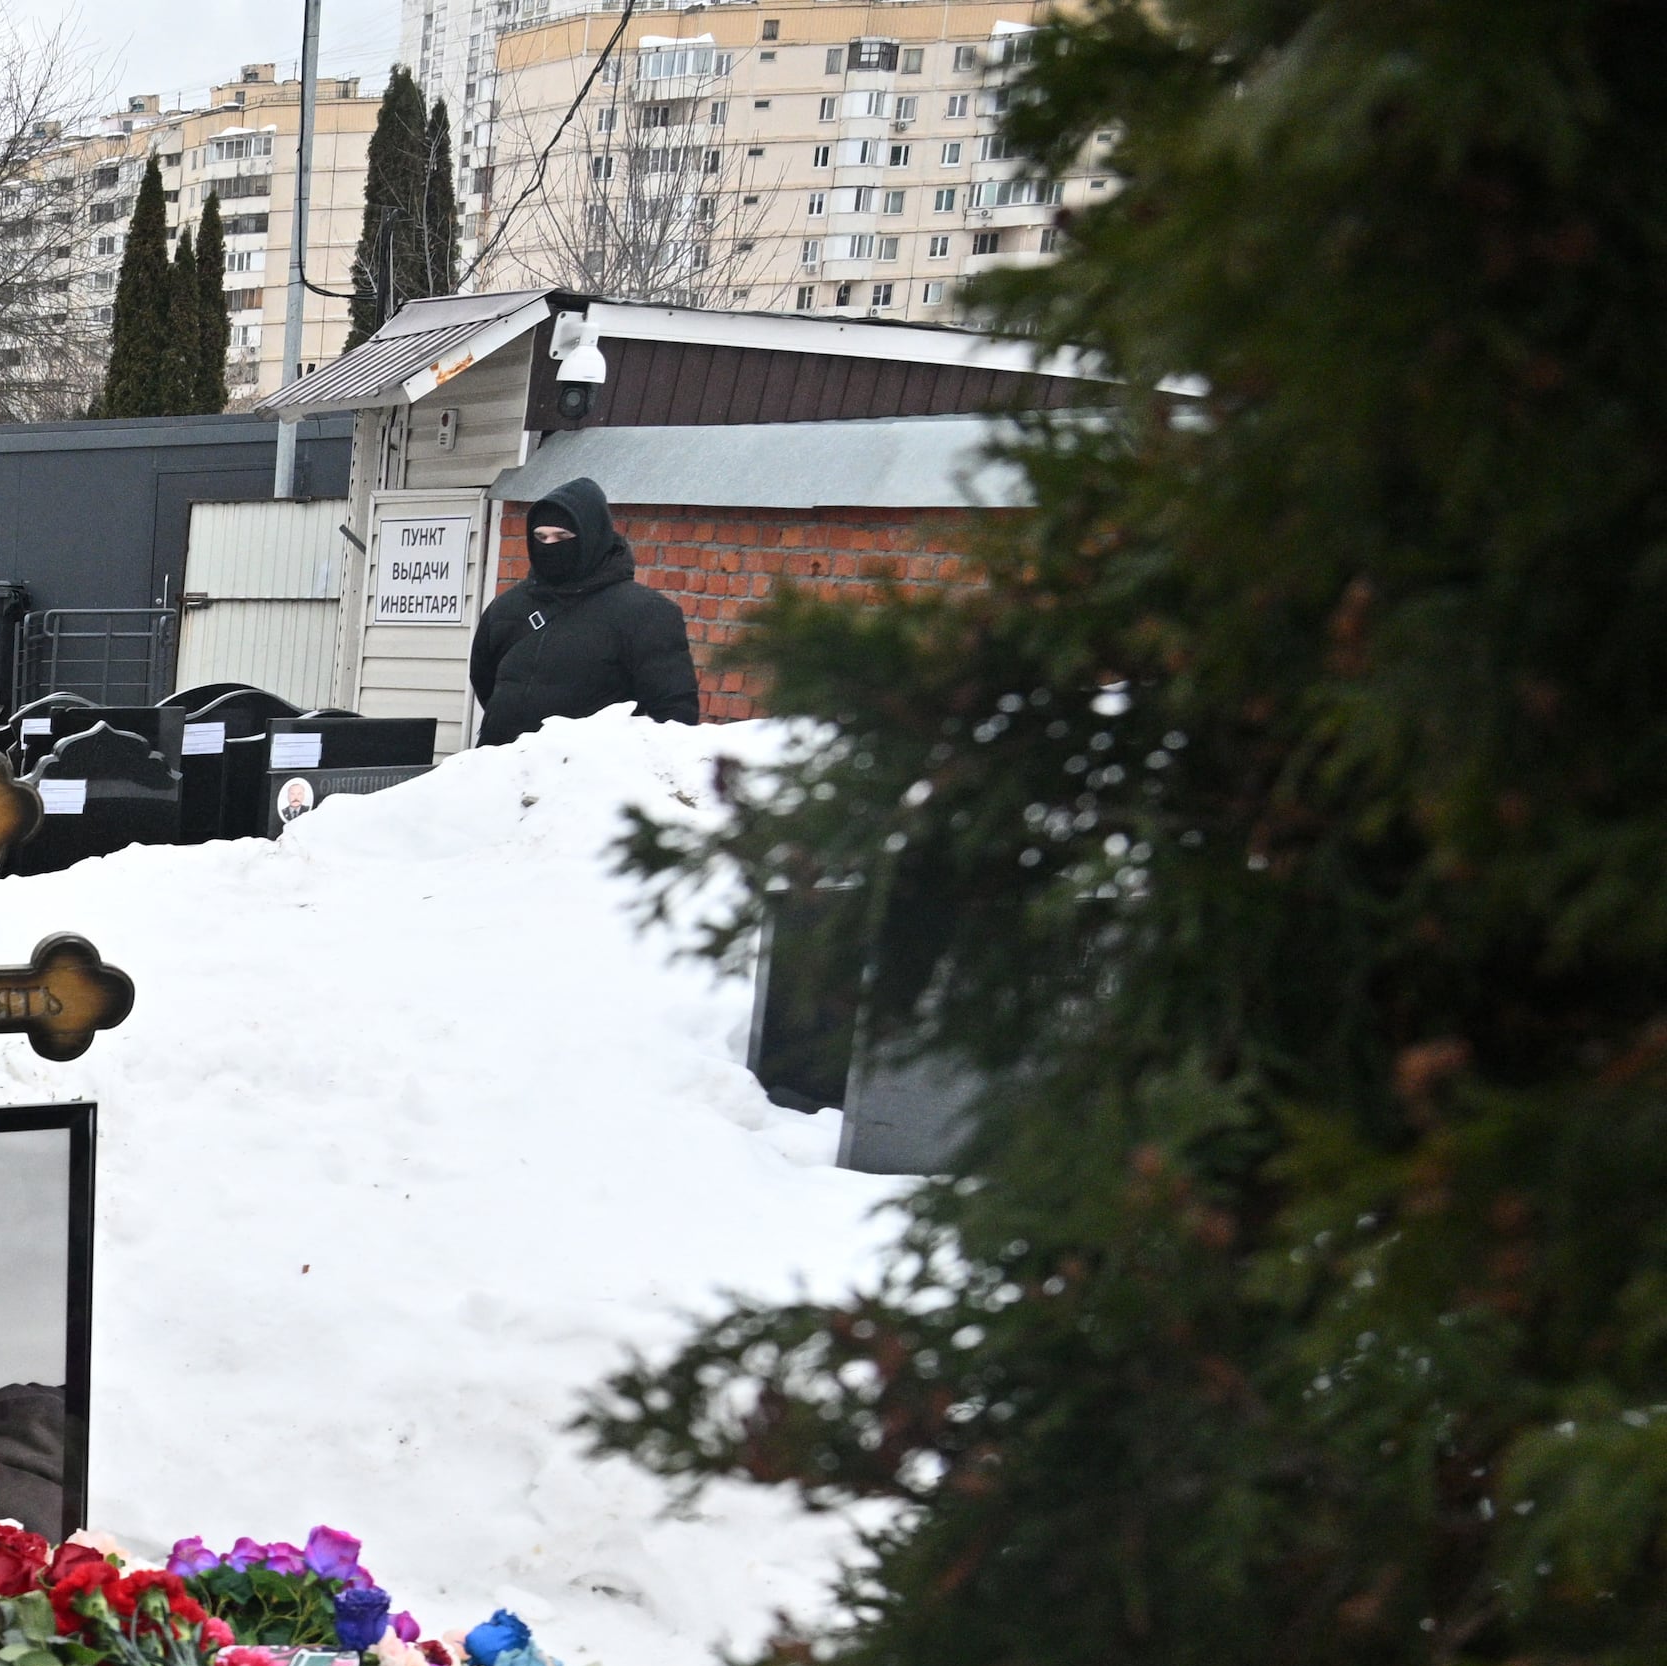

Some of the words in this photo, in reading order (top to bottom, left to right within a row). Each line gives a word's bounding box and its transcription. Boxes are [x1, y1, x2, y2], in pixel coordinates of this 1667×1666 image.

[401, 527, 446, 546] ПУНКТ
[392, 561, 449, 584] ВЫДАЧИ
[380, 595, 457, 614] ИНВЕНТАРЯ
